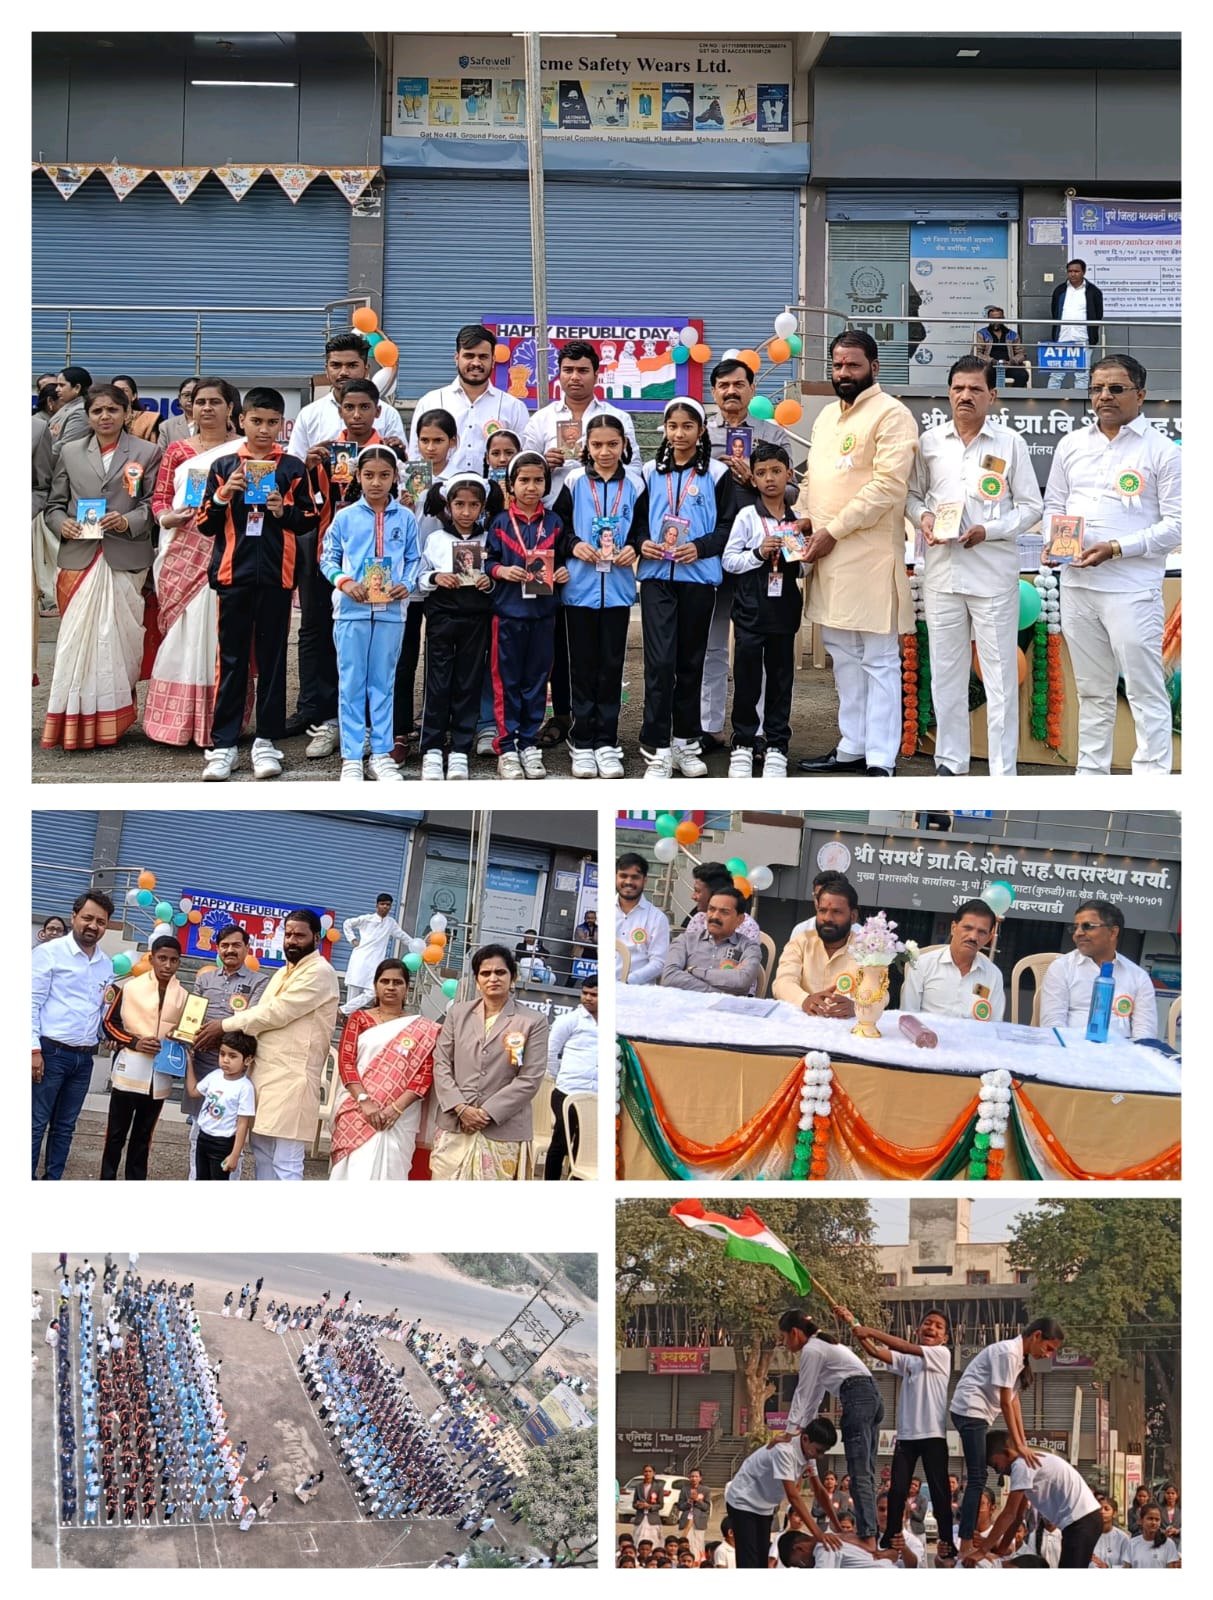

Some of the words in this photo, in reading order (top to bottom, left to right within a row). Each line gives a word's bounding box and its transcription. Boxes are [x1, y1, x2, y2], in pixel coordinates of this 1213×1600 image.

[470, 56, 511, 66] Safewell
[540, 59, 573, 71] cme
[578, 57, 631, 75] Safety
[637, 57, 690, 73] Wears
[696, 59, 731, 73] Ltd.
[851, 304, 883, 313] PDCC
[556, 326, 636, 339] REPUBLIC
[640, 327, 671, 340] DAY
[1044, 346, 1080, 358] ATM
[854, 843, 876, 865] श्री
[878, 846, 925, 868] समर्थ
[1130, 867, 1173, 890] मर्या.
[856, 871, 875, 883] मुख्य
[193, 896, 232, 910] HAPPY
[233, 902, 289, 918] REPUBLIC
[675, 1434, 702, 1443] Elegant
